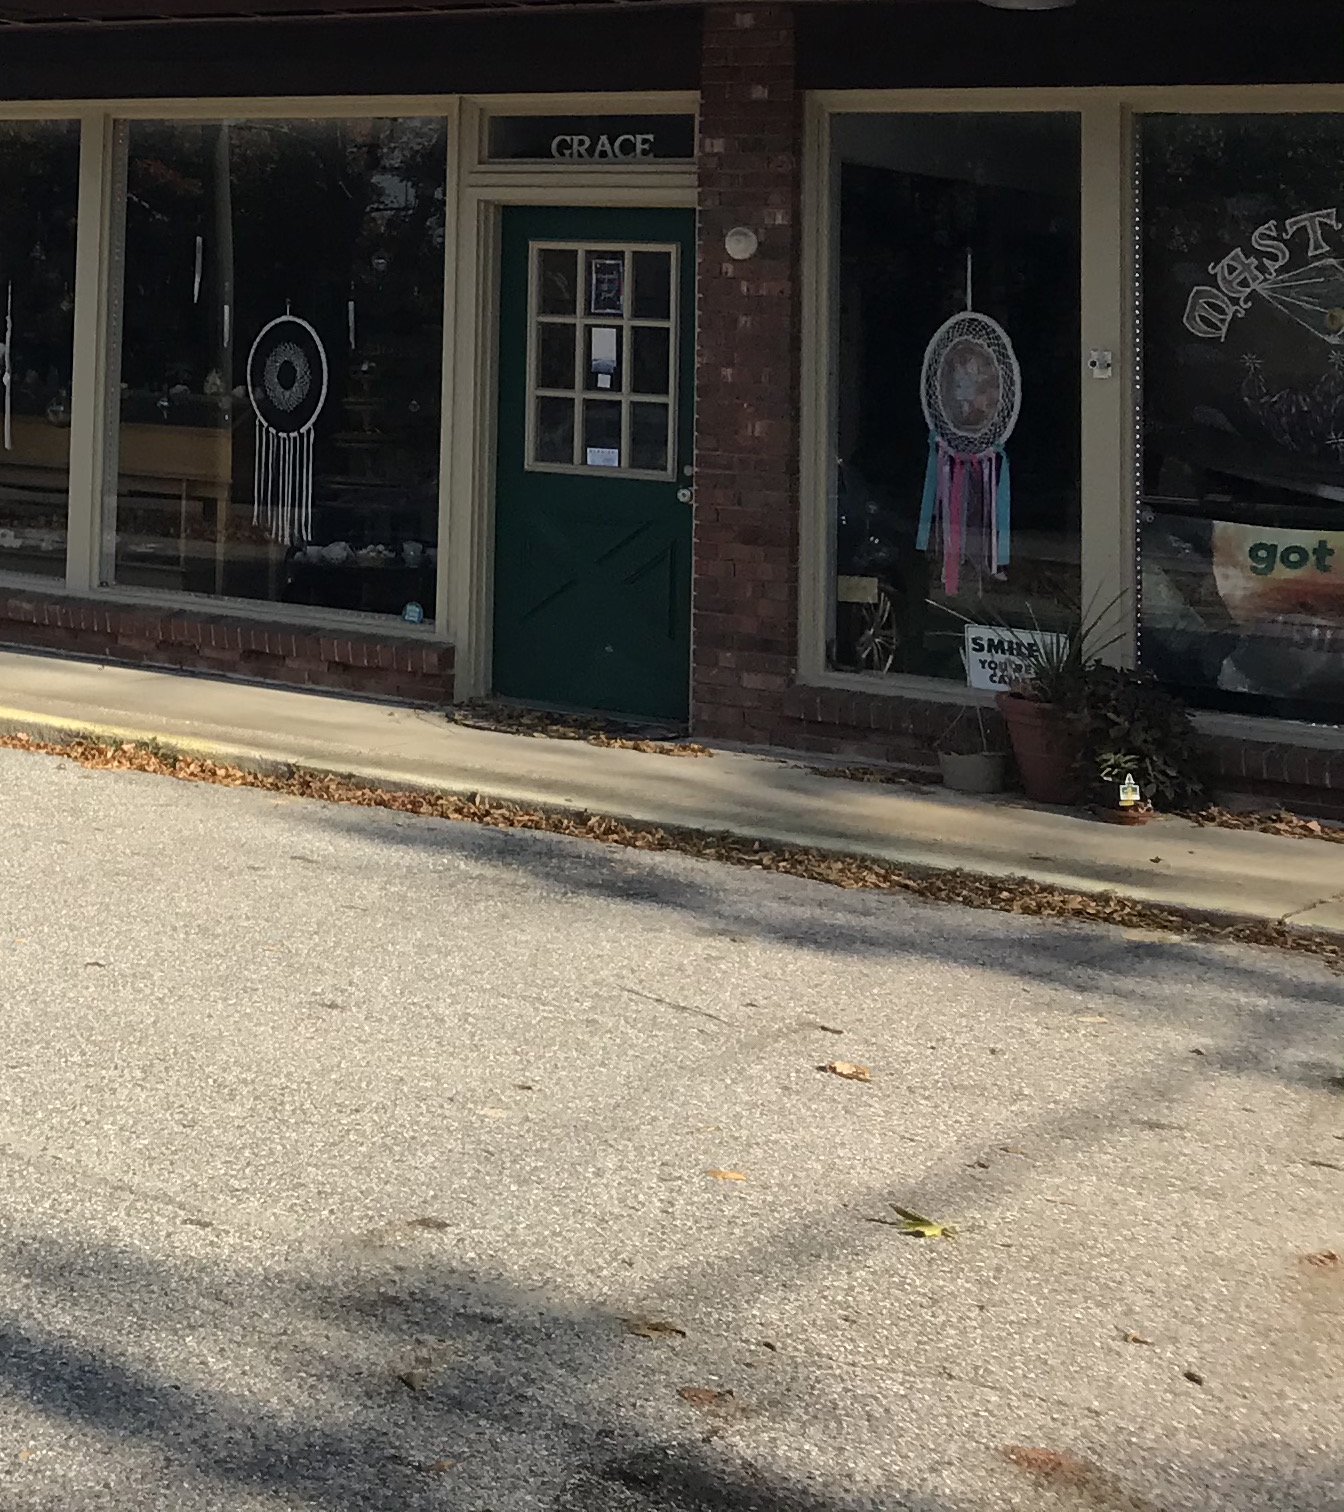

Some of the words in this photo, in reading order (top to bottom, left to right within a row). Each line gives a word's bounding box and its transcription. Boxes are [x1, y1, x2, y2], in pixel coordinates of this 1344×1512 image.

[550, 133, 655, 159] GRACE
[1248, 540, 1336, 576] got
[971, 635, 1041, 659] SMILE
